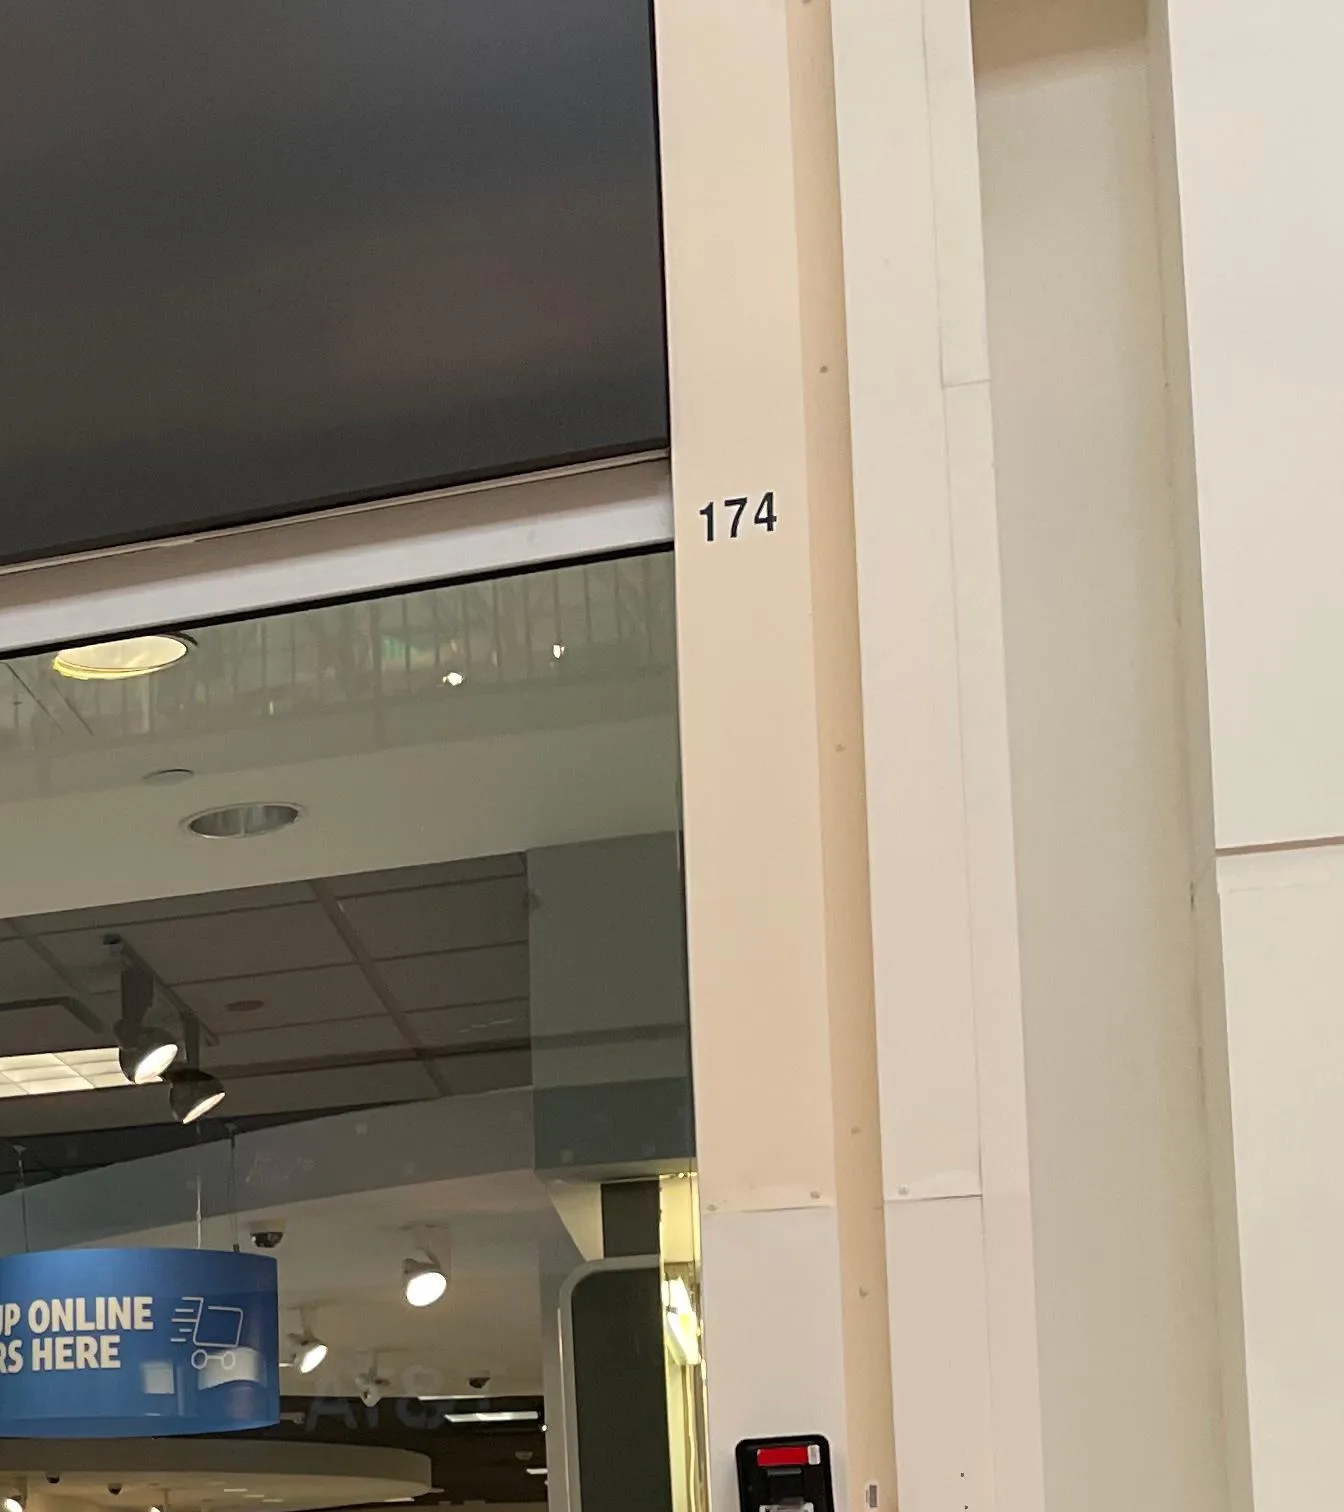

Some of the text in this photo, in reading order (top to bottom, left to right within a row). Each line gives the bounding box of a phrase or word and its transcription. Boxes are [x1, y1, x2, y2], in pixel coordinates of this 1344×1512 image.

[699, 491, 778, 542] 174
[27, 1296, 155, 1334] ONLINE
[31, 1334, 122, 1372] HERE
